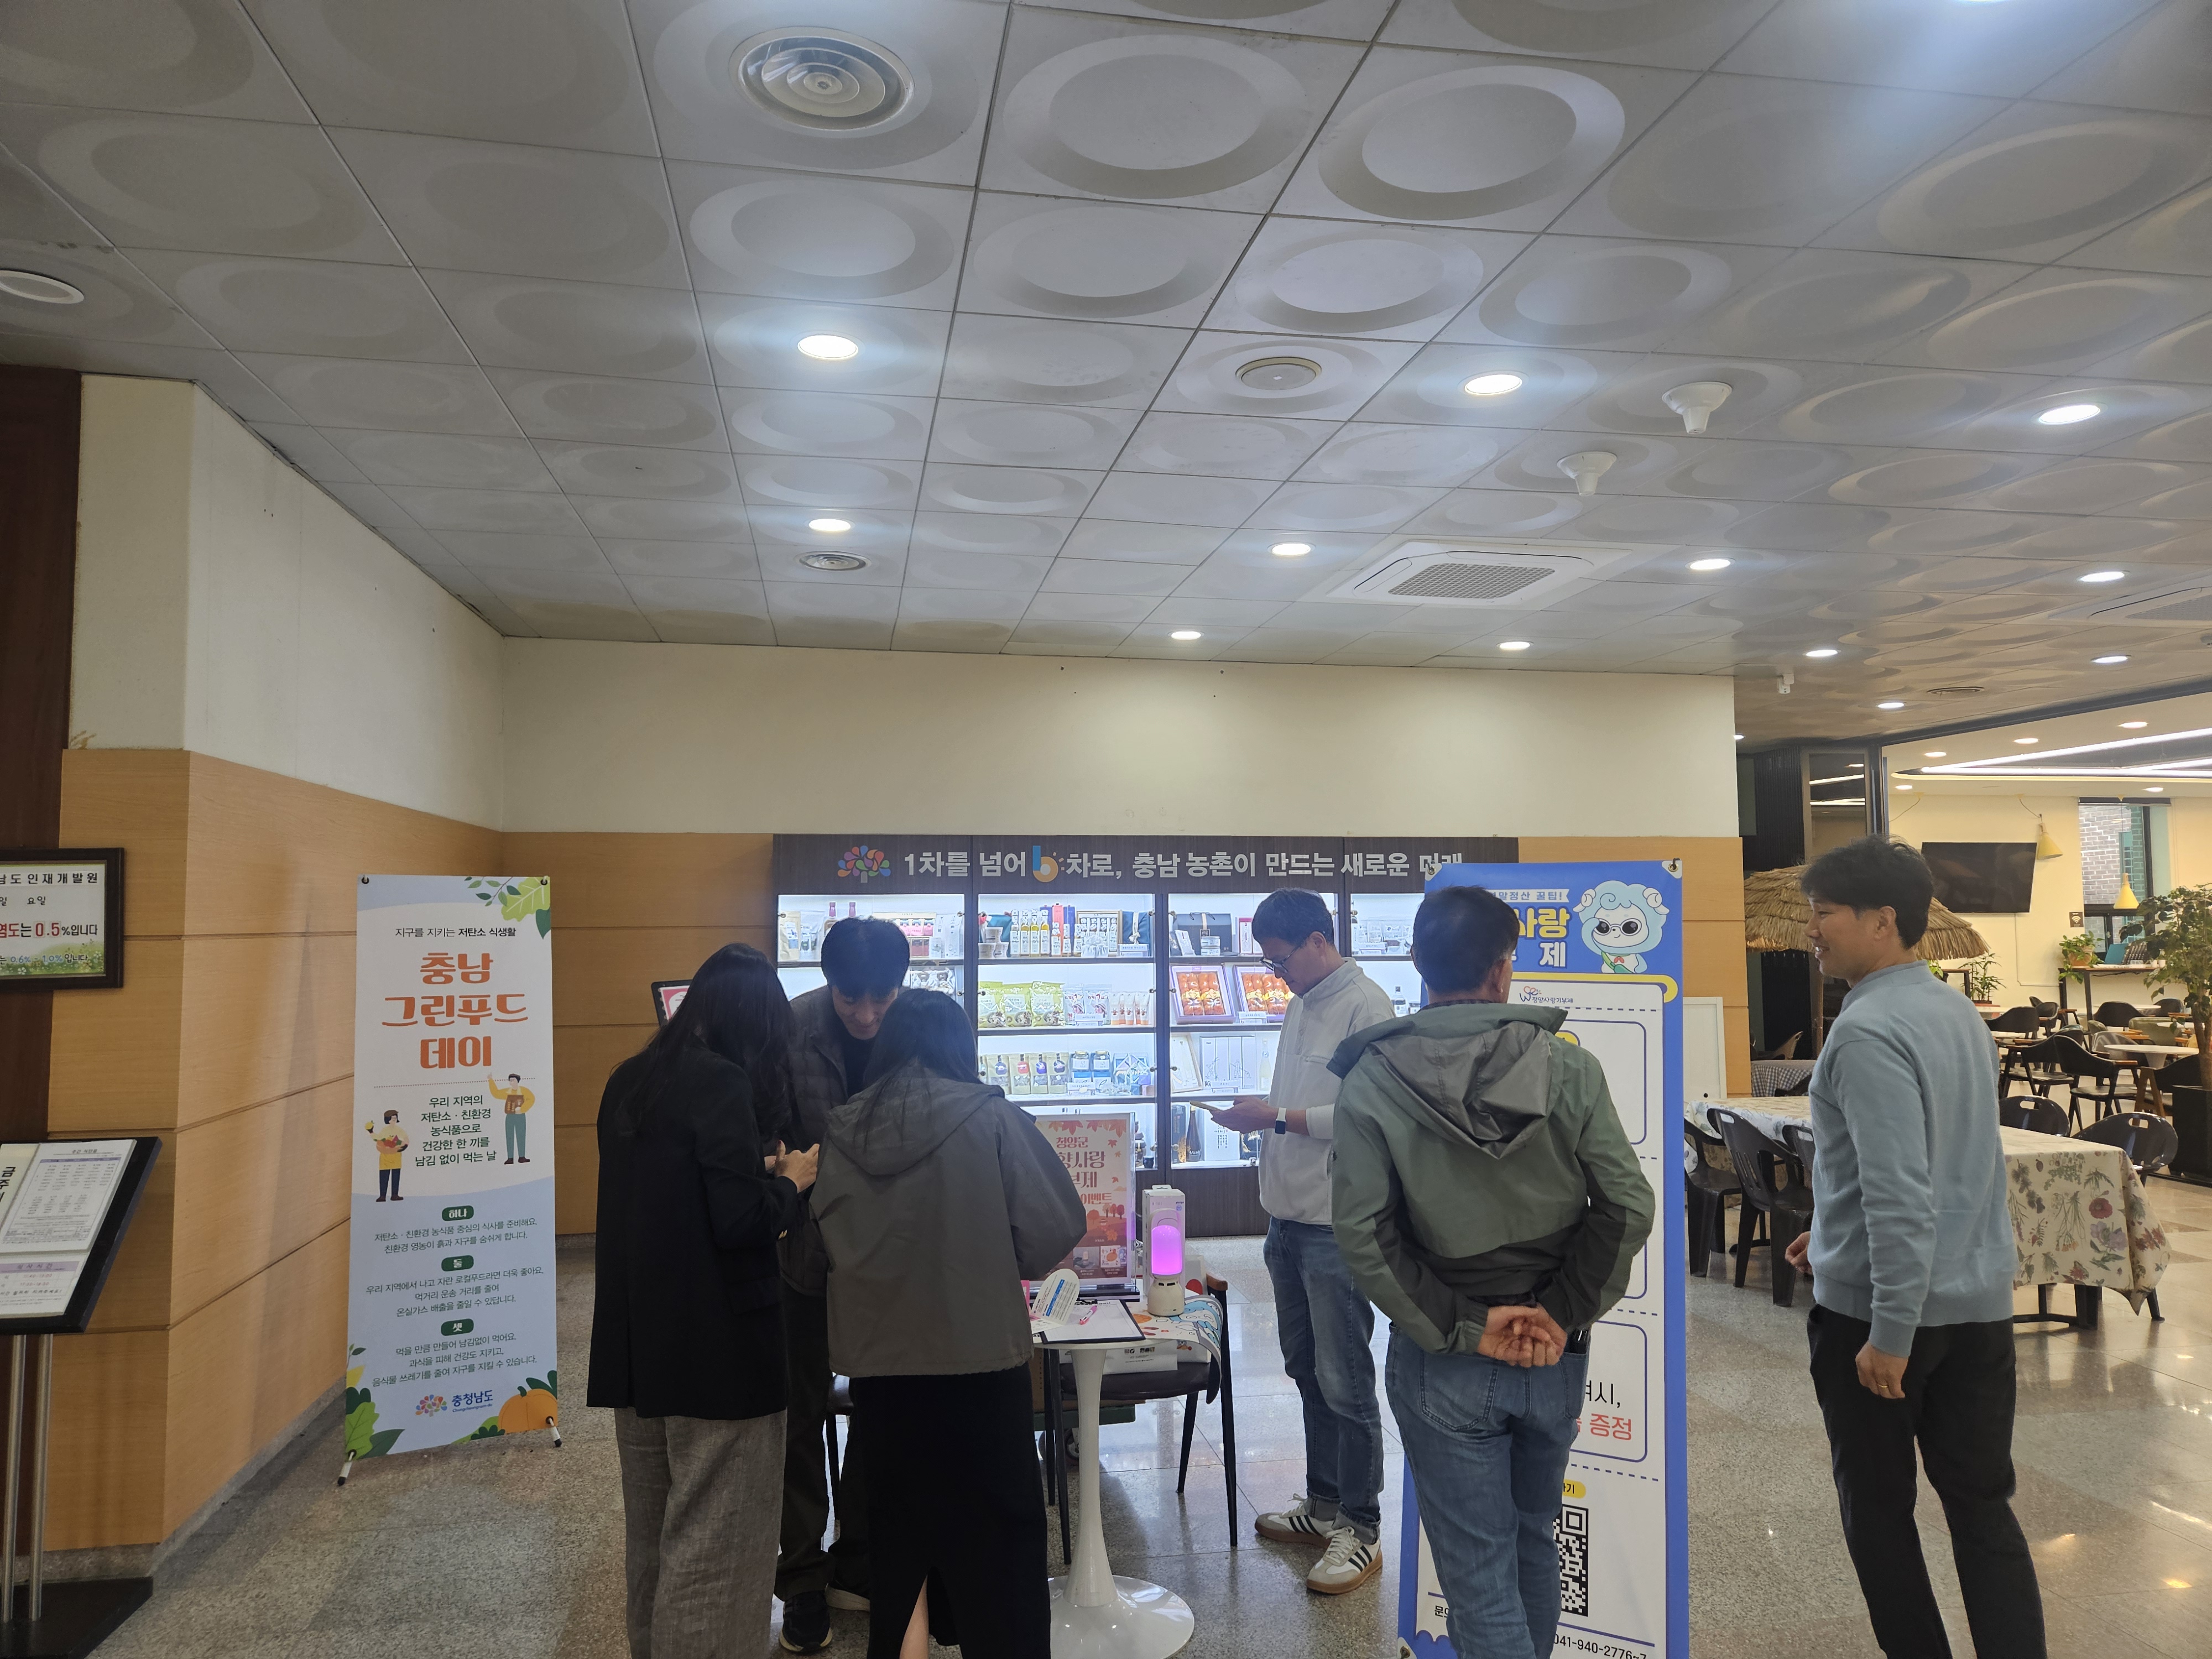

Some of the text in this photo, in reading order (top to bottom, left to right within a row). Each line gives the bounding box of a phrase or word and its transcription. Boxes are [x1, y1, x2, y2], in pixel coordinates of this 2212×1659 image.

[905, 852, 970, 877] 1차를
[979, 852, 1026, 877] 넘어
[1133, 853, 1180, 878] 충남
[1186, 852, 1255, 877] 농촌이
[1266, 853, 1335, 877] 만드는
[1340, 853, 1410, 877] 새로운
[27, 896, 46, 905] 요일
[1493, 891, 1562, 900] 말정산 꿀팁!
[395, 927, 516, 937] 지구를 지키는 저탄소 식생활
[64, 953, 88, 963] 입니다
[420, 952, 494, 984] 충남
[382, 993, 528, 1027] 그린푸드
[420, 1036, 492, 1068] 데이
[429, 1094, 483, 1108] 우리 지역의
[421, 1112, 451, 1123] 저탄소
[461, 1108, 491, 1120] 친환경
[430, 1124, 482, 1136] 농식품으로
[422, 1136, 490, 1151] 건강한 한 끼를
[1056, 1136, 1088, 1149] 청양군
[415, 1150, 497, 1167] 남김 없이 먹는 날
[448, 1208, 467, 1218] 하나
[374, 1232, 399, 1241] 저탄소
[406, 1228, 429, 1239] 친환경
[431, 1225, 455, 1236] 농식품
[457, 1223, 480, 1233] 중심의
[482, 1221, 504, 1230] 식사를
[384, 1230, 528, 1254] 친환경 영농이 흙과 지구를 숨쉬게 합니다.
[453, 1259, 462, 1268] 둘
[366, 1284, 383, 1294] 우리
[385, 1280, 417, 1292] 지역에서
[419, 1279, 435, 1287] 나고
[437, 1276, 453, 1286] 자란
[455, 1271, 500, 1284] 로컬푸드라면
[503, 1269, 519, 1277] 더욱
[415, 1284, 499, 1301] 먹거리 운송 거리를 줄여
[397, 1306, 429, 1317] 온실가스
[431, 1302, 455, 1312] 배출을
[456, 1300, 472, 1310] 줄일
[484, 1295, 516, 1306] 있답니다.
[452, 1322, 462, 1332] 셋
[396, 1347, 412, 1356] 먹을
[415, 1344, 431, 1354] 만큼
[433, 1340, 456, 1351] 만들어
[459, 1335, 489, 1348] 남김없이
[409, 1357, 433, 1367] 과식을
[435, 1354, 451, 1364] 피해
[453, 1351, 477, 1361] 건강도
[372, 1355, 537, 1387] 음식물 쓰레기를 줄여 지구를 지킬 수 있습니다.
[452, 1390, 493, 1407] 충청남도
[1589, 1413, 1632, 1441] 증정
